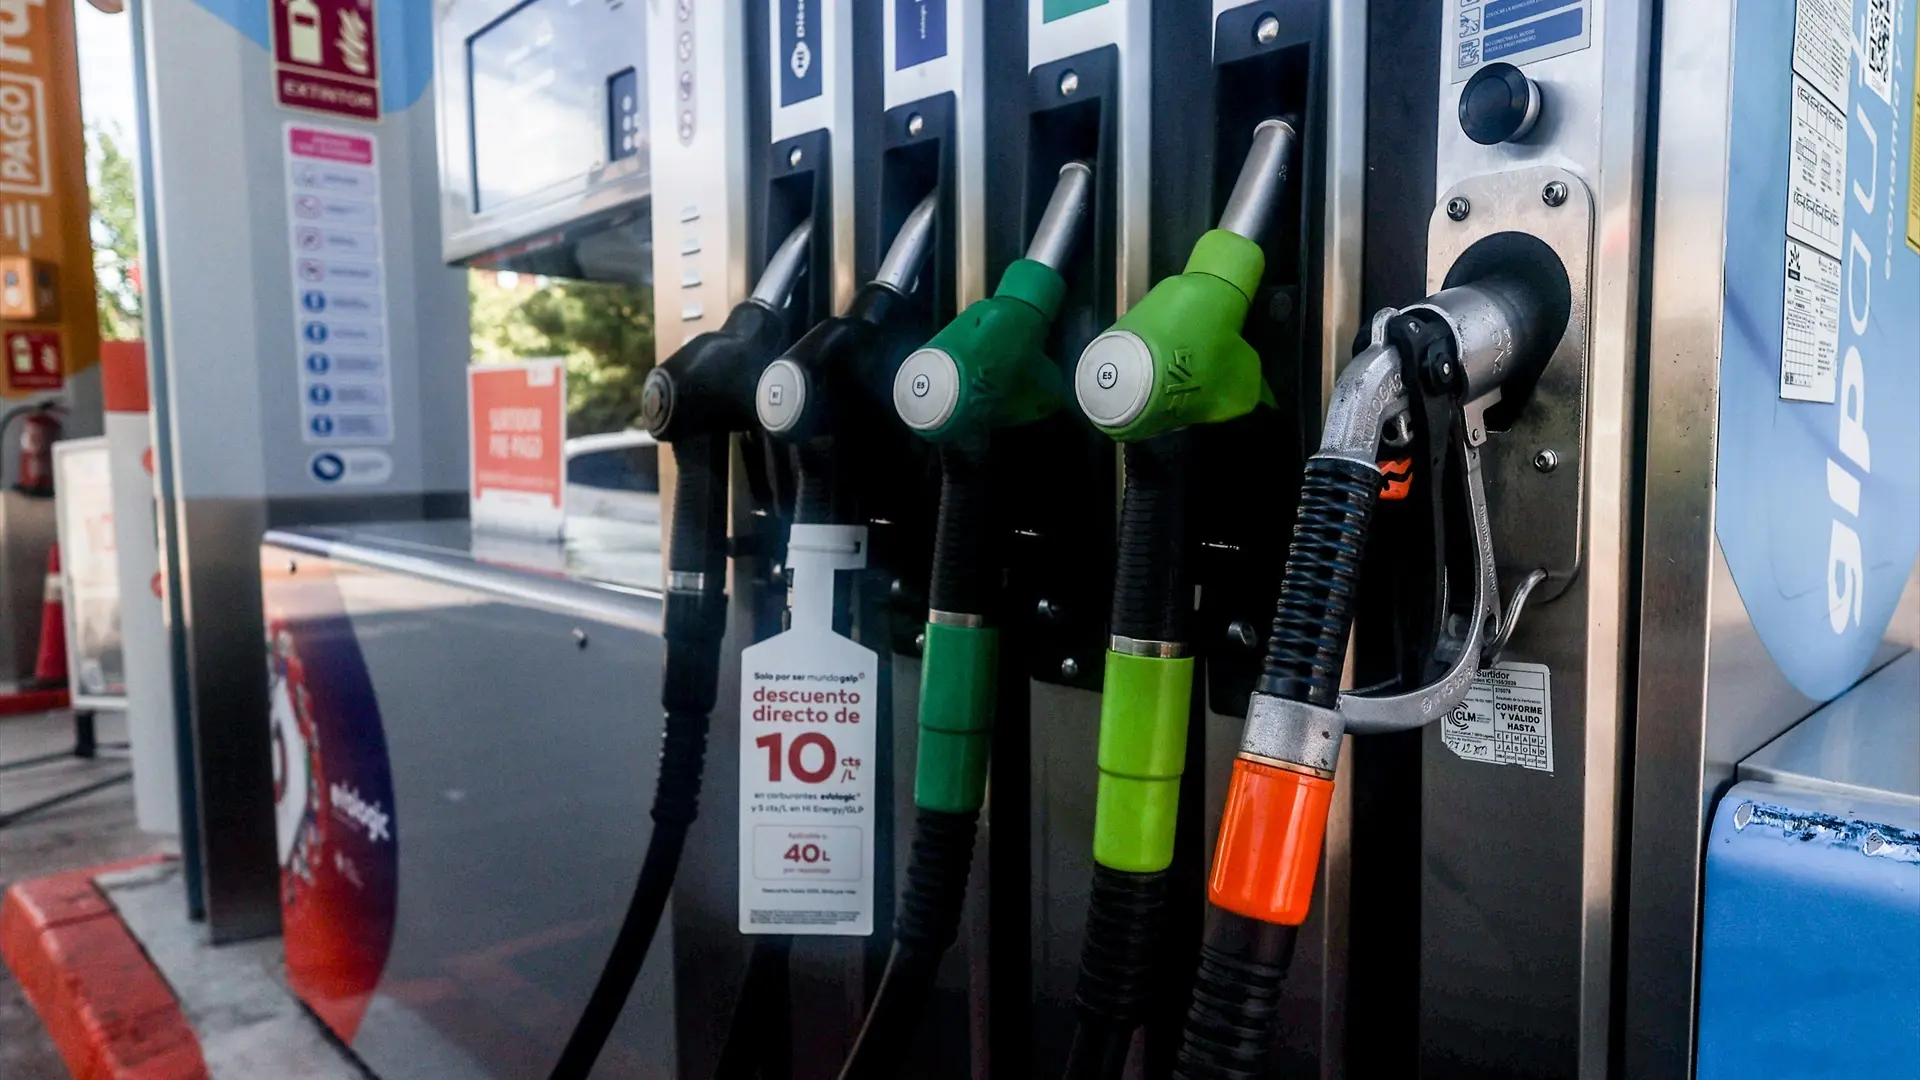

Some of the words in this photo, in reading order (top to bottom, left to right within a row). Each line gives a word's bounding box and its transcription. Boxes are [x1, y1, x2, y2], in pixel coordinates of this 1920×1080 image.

[282, 78, 374, 108] EXTINTOR
[0, 84, 35, 181] PAGO
[1102, 371, 1112, 380] E5
[916, 381, 925, 390] E5
[488, 407, 543, 432] SURTIDOR
[754, 672, 774, 680] Solo
[775, 674, 790, 682] por
[1476, 669, 1510, 680] Surtidor
[753, 685, 861, 704] descuento
[753, 704, 829, 723] directo
[834, 706, 860, 723] de
[1495, 702, 1543, 715] CONFORME
[1455, 710, 1476, 723] CLM
[1508, 712, 1541, 724] VÁLIDO
[1507, 723, 1536, 733] HASTA
[755, 732, 837, 784] 10
[841, 756, 861, 767] cts
[840, 768, 856, 784] /L
[766, 792, 818, 800] carburantes
[766, 804, 787, 814] cts/L
[813, 804, 864, 815] Energy/GLP
